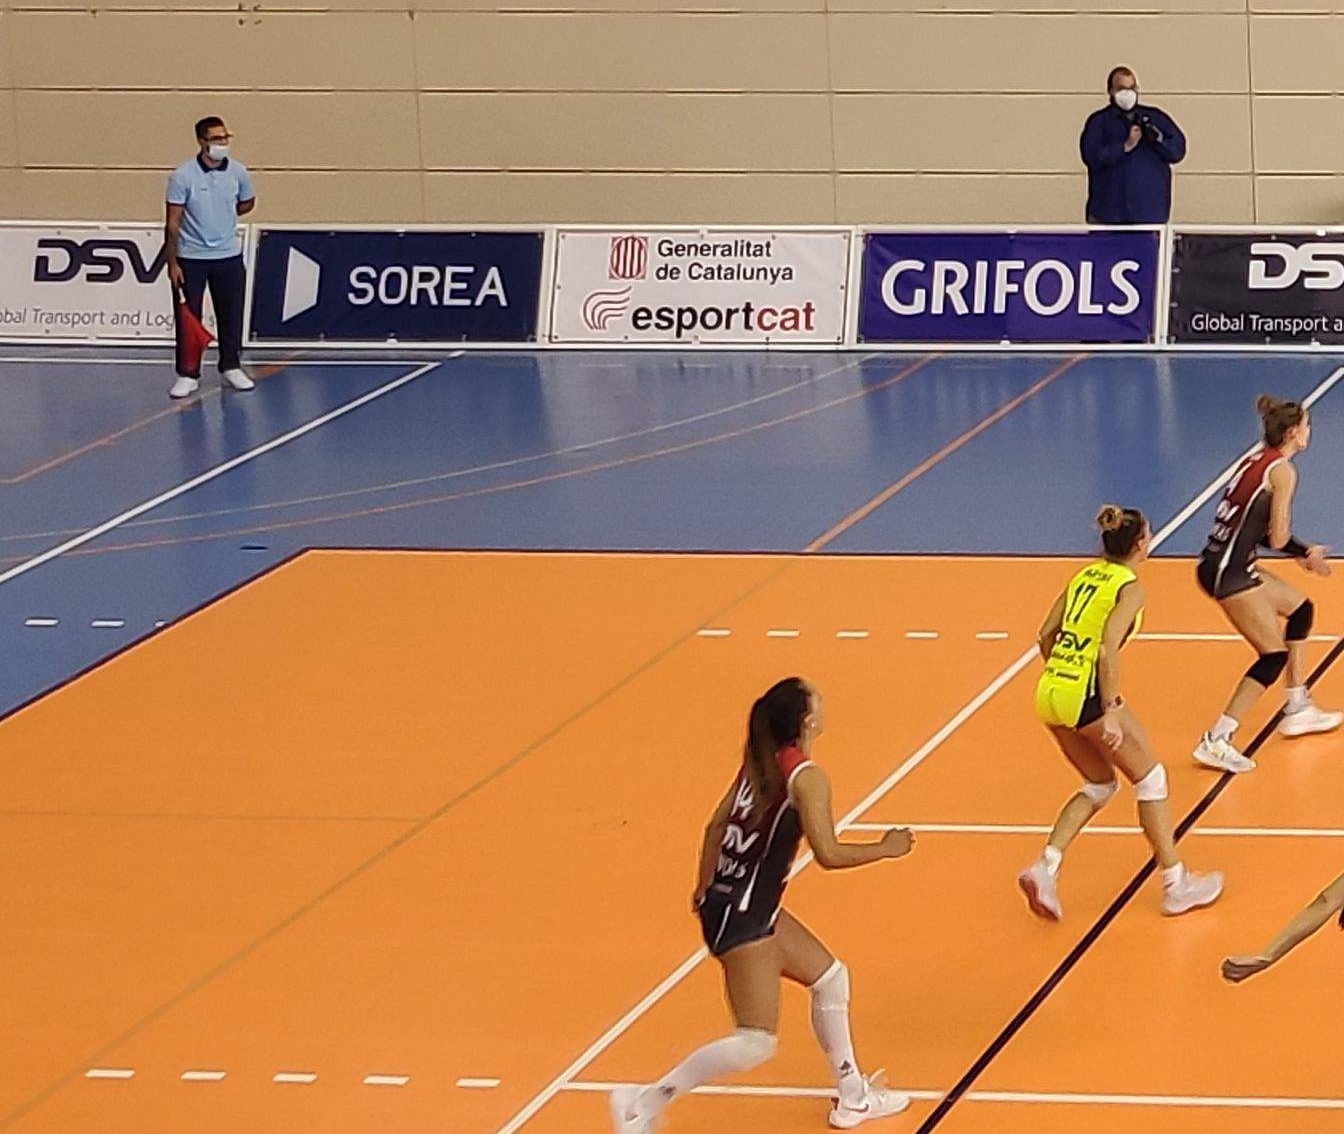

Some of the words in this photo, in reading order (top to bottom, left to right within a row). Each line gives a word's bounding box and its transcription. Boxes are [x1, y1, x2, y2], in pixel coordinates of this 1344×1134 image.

[657, 239, 773, 259] Generalitat
[347, 266, 508, 308] SOREA
[655, 262, 680, 281] de
[687, 262, 794, 285] Catalunya
[881, 259, 1140, 316] GRIFOLS
[32, 308, 105, 328] Transport
[110, 310, 141, 326] and
[631, 300, 816, 339] esportcat
[1191, 313, 1244, 332] Global
[1249, 313, 1328, 336] Transport
[1066, 581, 1098, 625] 17
